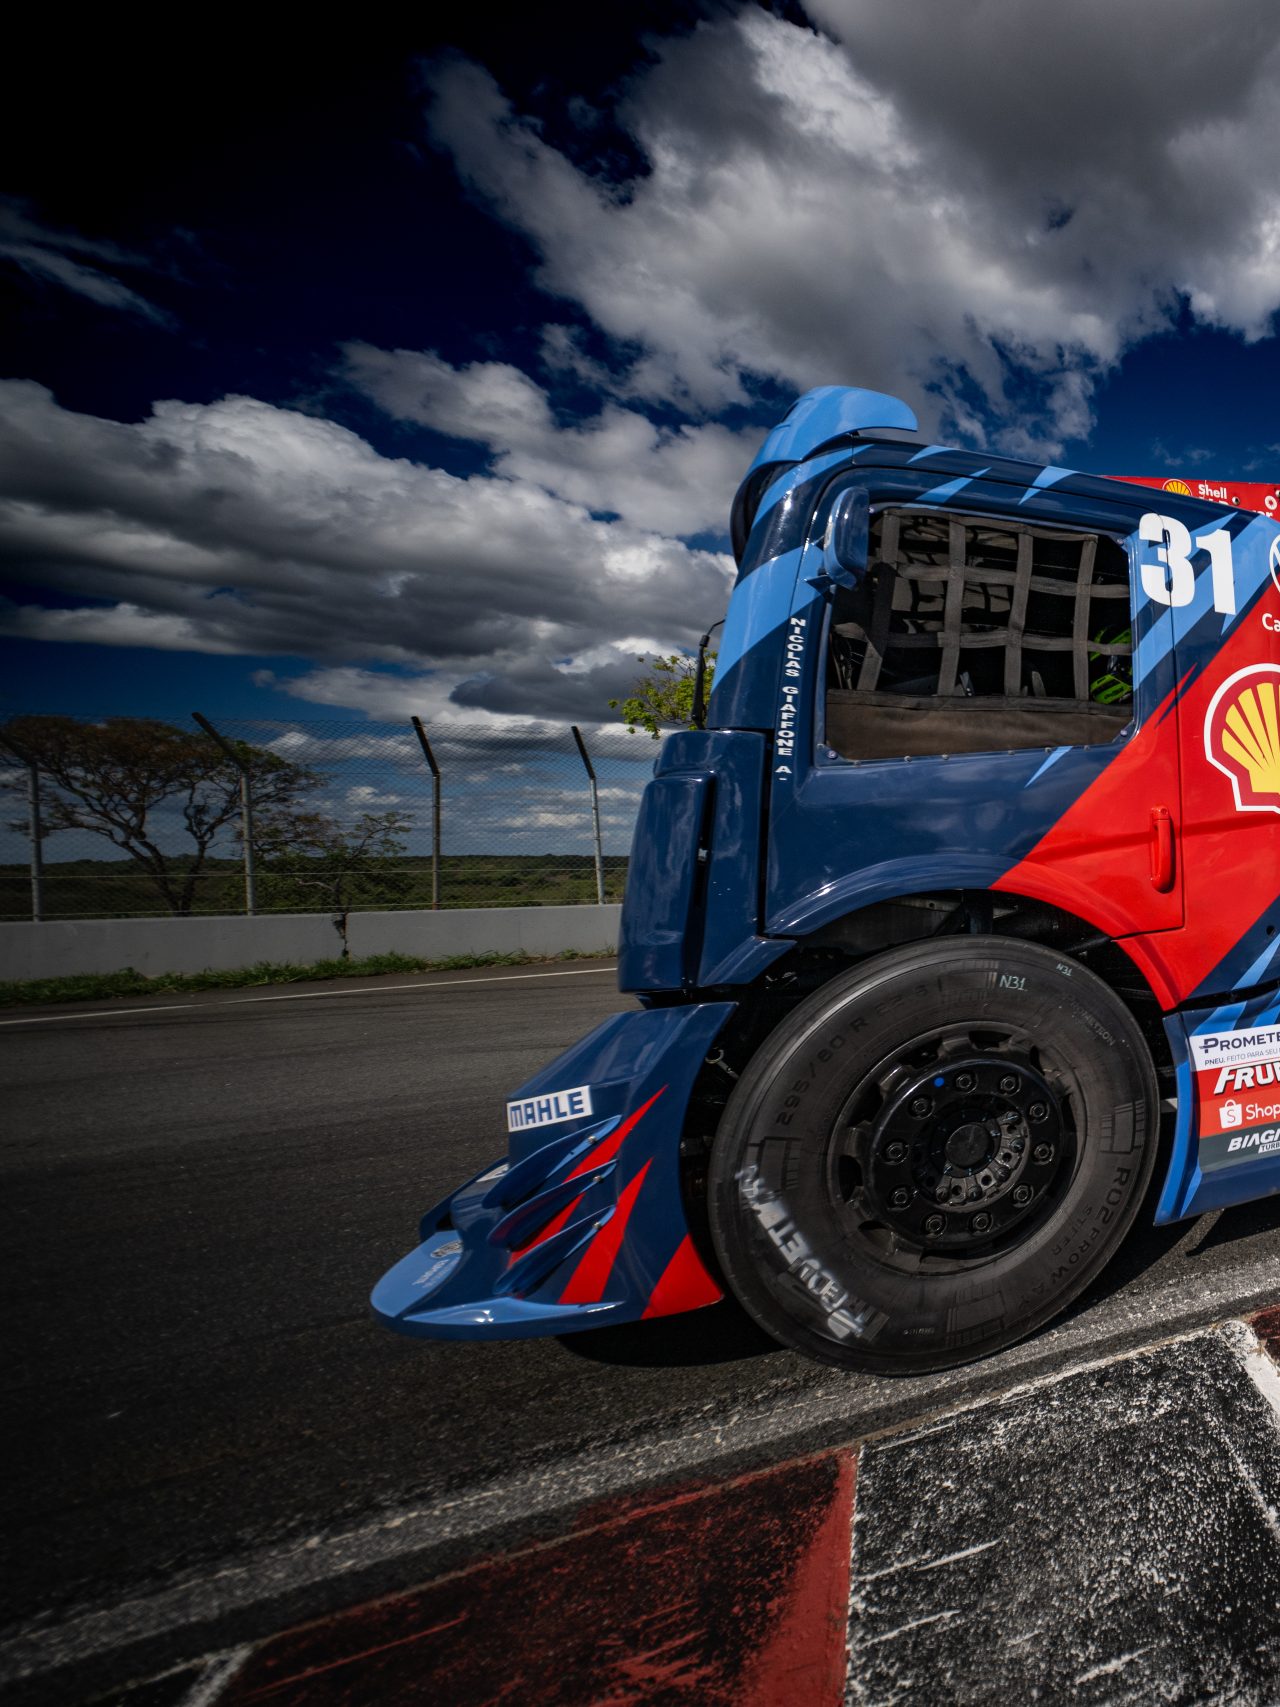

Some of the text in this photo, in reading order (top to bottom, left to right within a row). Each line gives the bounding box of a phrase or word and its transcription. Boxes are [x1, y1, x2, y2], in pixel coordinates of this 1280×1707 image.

[1198, 483, 1228, 499] Shell
[1138, 512, 1237, 616] 31
[785, 617, 806, 678] NICOLAS
[777, 686, 799, 757] GIAFFONE
[999, 974, 1027, 991] N31
[1056, 963, 1073, 977] N31
[1204, 1057, 1226, 1066] PNEU.
[1226, 1053, 1246, 1064] FEITO
[1247, 1050, 1264, 1059] PARA
[1265, 1047, 1278, 1055] SEU
[509, 1090, 585, 1128] MAHLE
